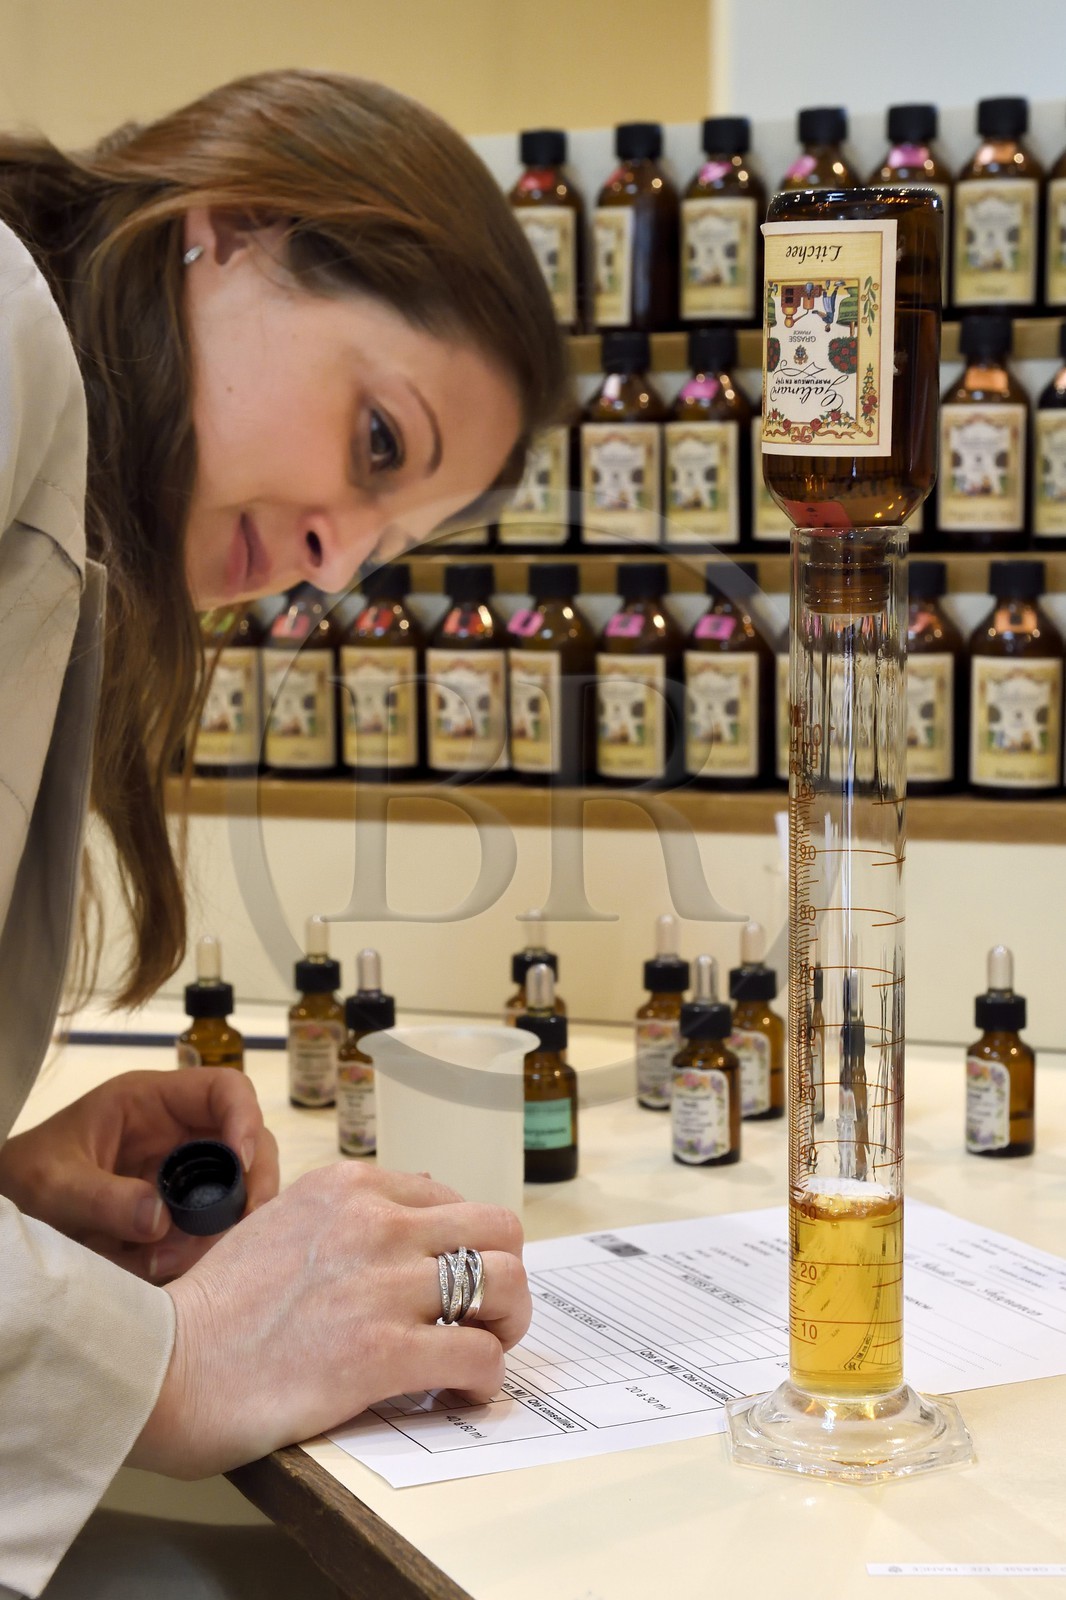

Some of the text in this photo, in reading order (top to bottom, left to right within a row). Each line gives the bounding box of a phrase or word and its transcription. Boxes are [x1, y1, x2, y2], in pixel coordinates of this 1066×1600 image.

[785, 245, 843, 265] Litchee
[788, 335, 816, 343] GRASSE
[770, 374, 849, 412] Galimard
[800, 1203, 817, 1221] 30
[800, 1262, 817, 1281] 20
[802, 1321, 818, 1340] 10
[469, 1431, 488, 1439] ml
